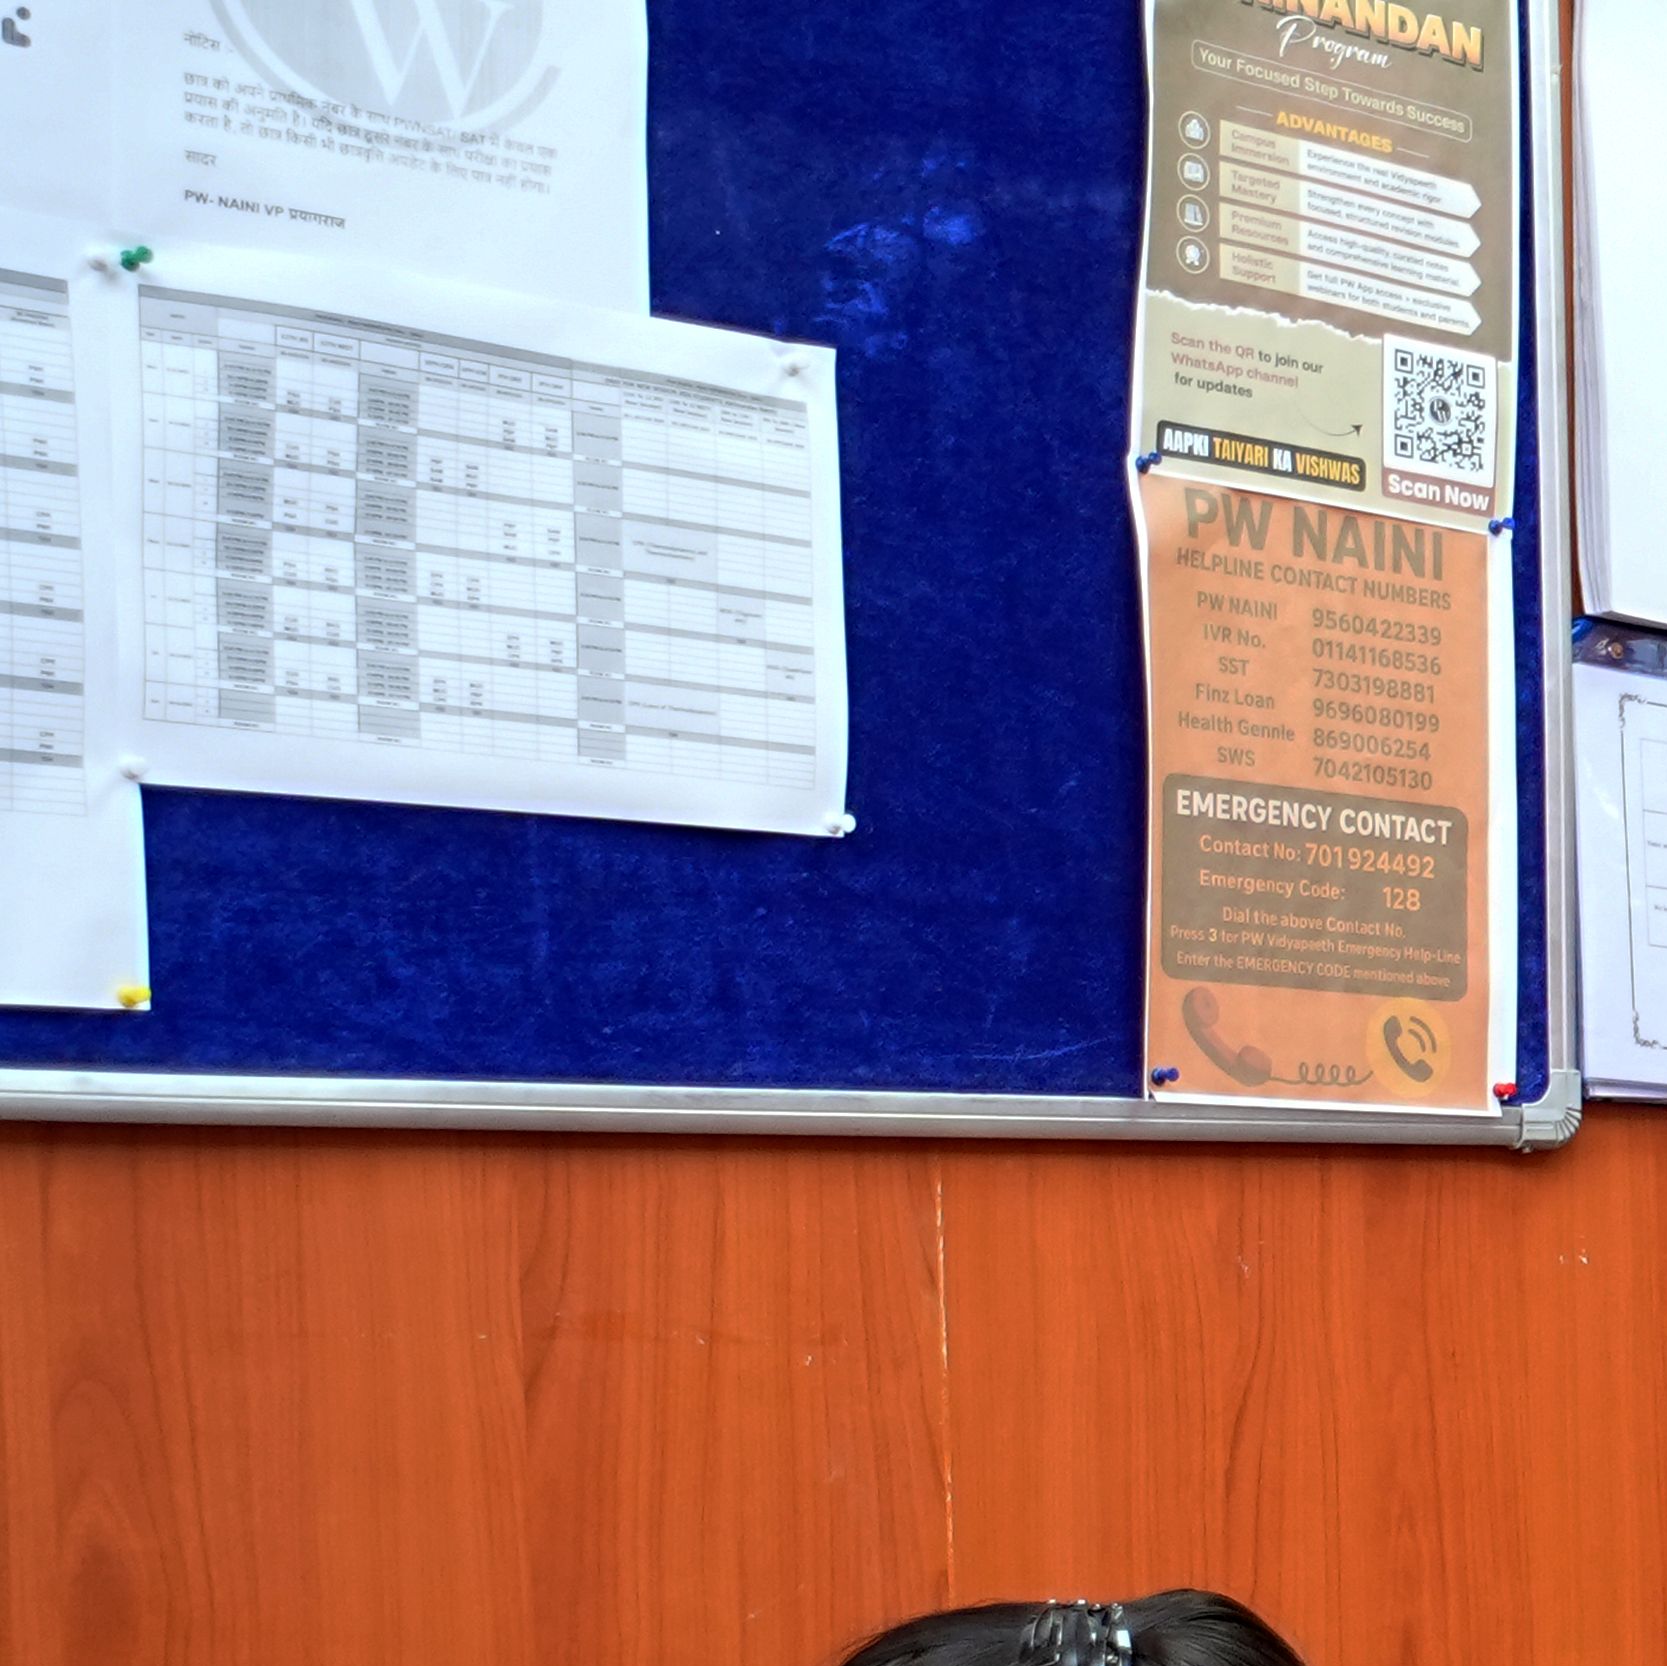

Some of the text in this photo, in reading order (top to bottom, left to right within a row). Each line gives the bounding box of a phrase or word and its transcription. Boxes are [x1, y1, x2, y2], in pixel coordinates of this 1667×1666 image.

[1276, 15, 1392, 70] Program
[1200, 48, 1465, 134] Your Focused Step Towards Success
[1276, 111, 1393, 153] ADVANTAGES
[1231, 170, 1281, 190] Targeted
[217, 195, 261, 214] NAINI
[264, 203, 284, 218] VP
[1231, 210, 1282, 231] Premium
[1231, 225, 1289, 246] Resources
[1231, 264, 1276, 285] Support
[1172, 332, 1323, 375] Scan the QR to join our
[1172, 352, 1299, 389] WhatsApp channel
[1175, 371, 1254, 400] for updates
[1163, 427, 1361, 486] AAPKI TAIYARI KA VISHWAS
[1388, 473, 1490, 512] Scan Now
[1185, 487, 1444, 581] PW NAINI
[1176, 547, 1452, 611] HELPLINE CONTACT NUMBERS
[1197, 590, 1278, 621] PW NAINI
[1202, 623, 1266, 650] IVR No.
[1312, 607, 1443, 647] 9560422339
[1218, 655, 1249, 677] SST
[1312, 637, 1442, 677] 01141168536
[1195, 682, 1276, 712] Finz Loan
[1312, 667, 1436, 704] 7303198881
[1177, 710, 1234, 735] Health
[1312, 697, 1441, 733] 9696080199
[1216, 746, 1256, 767] SWS
[1313, 727, 1432, 761] 869006254
[1312, 757, 1433, 791] 7042105130
[1176, 789, 1452, 846] EMERGENCY CONTACT
[1200, 834, 1270, 859] Contact
[1273, 842, 1301, 863] No:
[1200, 869, 1422, 912] Emergency Code: 128
[1223, 907, 1406, 939] Dial the above Contact No.
[1171, 925, 1462, 965] Press 3 for PW Vidyapeeth Emergency Help-Line
[1176, 951, 1451, 988] Enter the EMERGENCY CODE mentioned above
